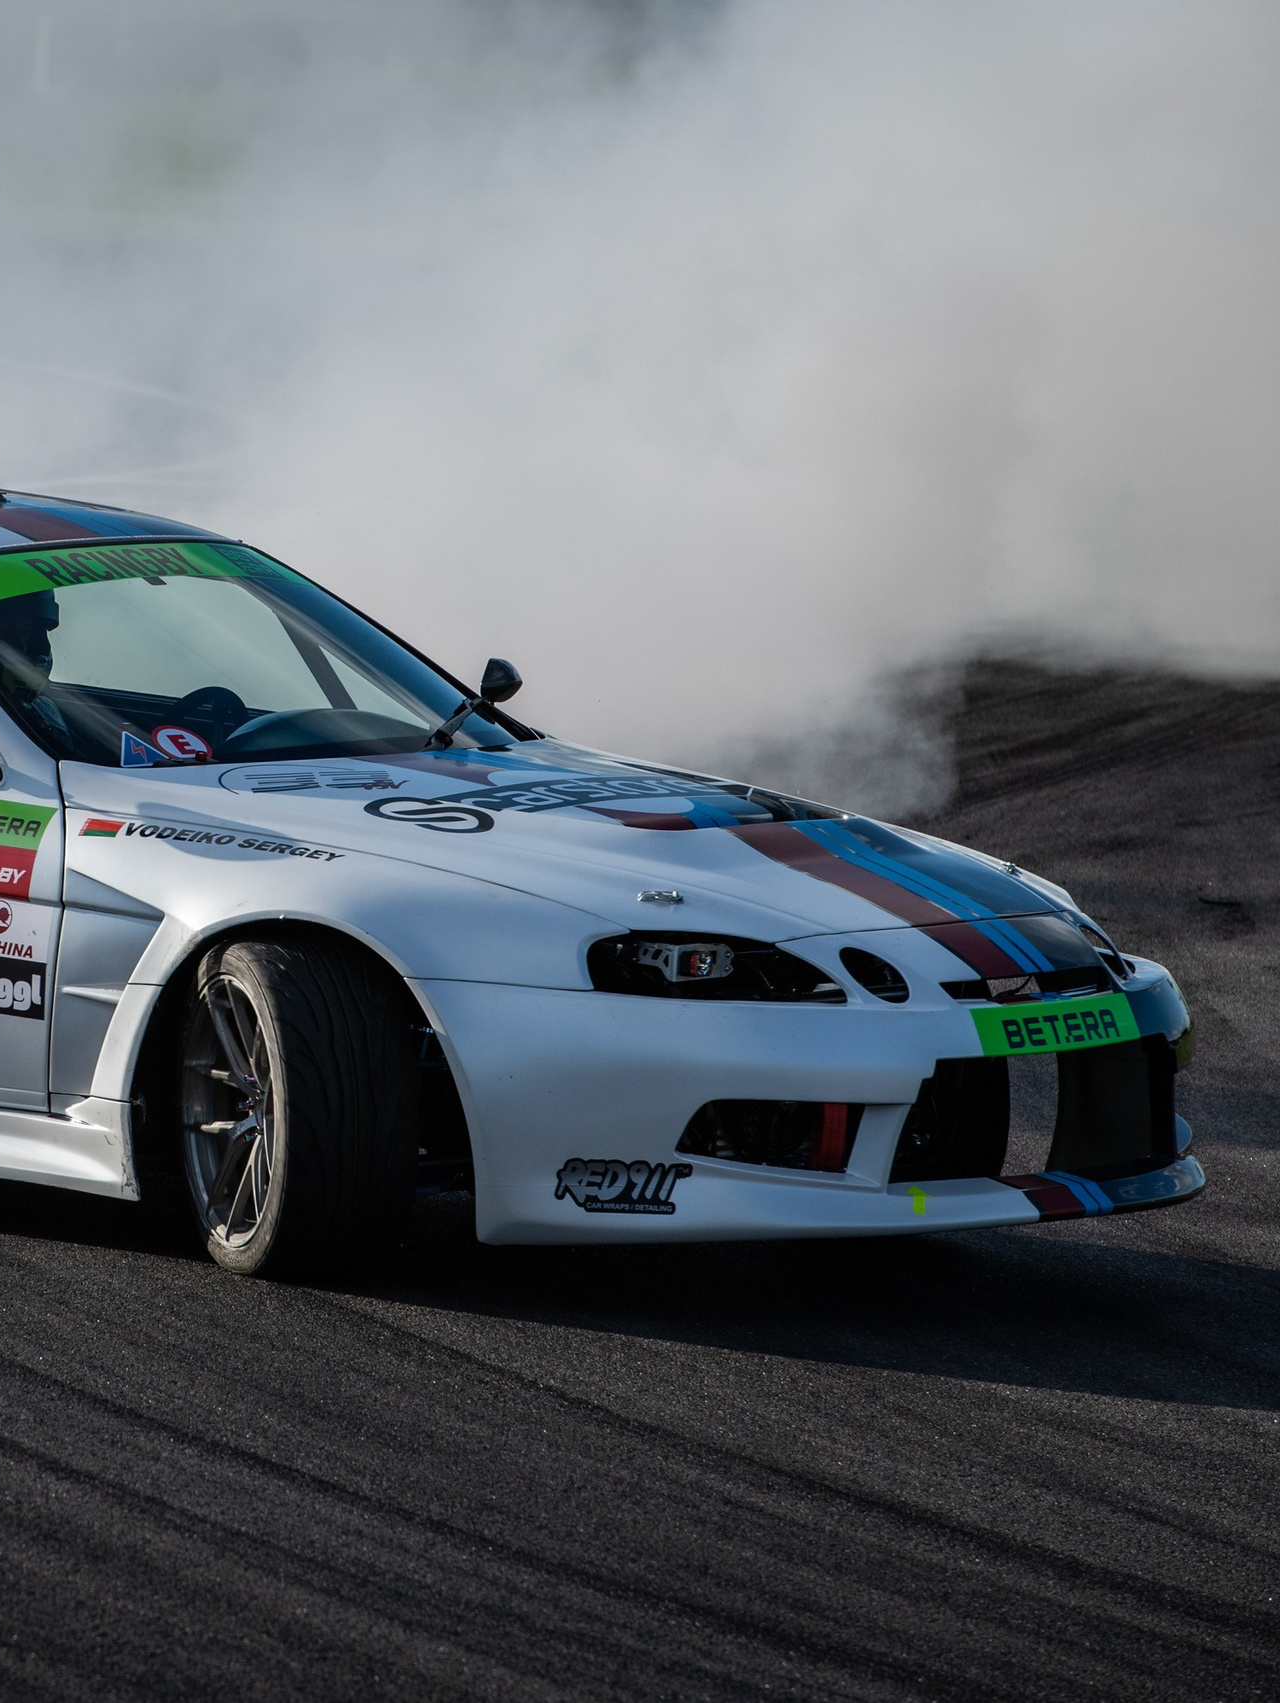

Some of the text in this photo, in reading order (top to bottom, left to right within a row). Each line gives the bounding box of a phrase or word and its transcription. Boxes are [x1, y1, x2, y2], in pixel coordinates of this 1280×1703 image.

[124, 822, 346, 863] VODEIKO SERGEY
[603, 1203, 630, 1211] WRAPS
[635, 1204, 673, 1212] DETAILING
